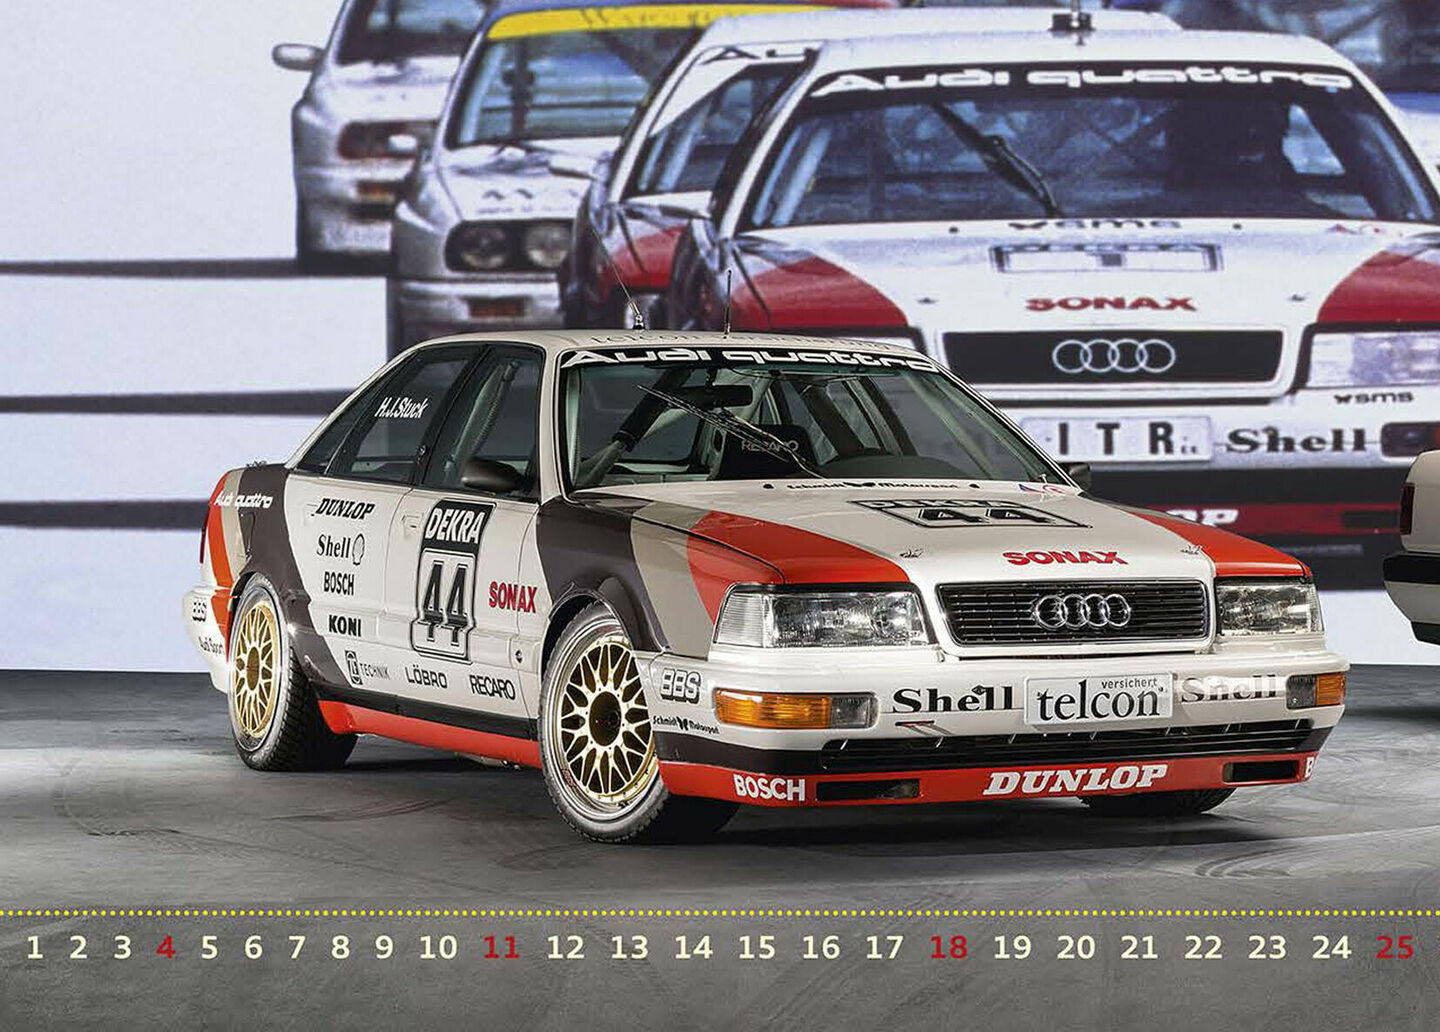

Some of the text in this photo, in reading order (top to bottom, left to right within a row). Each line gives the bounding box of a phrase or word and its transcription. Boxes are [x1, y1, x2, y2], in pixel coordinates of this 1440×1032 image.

[811, 67, 1353, 98] Audi quattro
[1025, 296, 1198, 312] SONAX
[562, 346, 939, 373] Audi quattro
[1226, 427, 1366, 454] Shell
[315, 497, 375, 520] DUNLOP
[425, 507, 486, 544] DEKRA
[316, 534, 351, 559] Shell
[1002, 550, 1127, 565] SONAX
[323, 571, 355, 596] BOSCH
[489, 580, 538, 614] SONAX
[422, 559, 470, 648] 44
[328, 614, 362, 638] KONI
[405, 666, 448, 690] LÖBRO
[469, 674, 515, 702] RECARO
[661, 669, 701, 705] BBS
[1101, 677, 1158, 689] versichert
[893, 673, 1278, 714] Shell Shell
[1037, 680, 1161, 722] telcon
[733, 774, 806, 802] BOSCH
[982, 764, 1168, 797] DUNLOP
